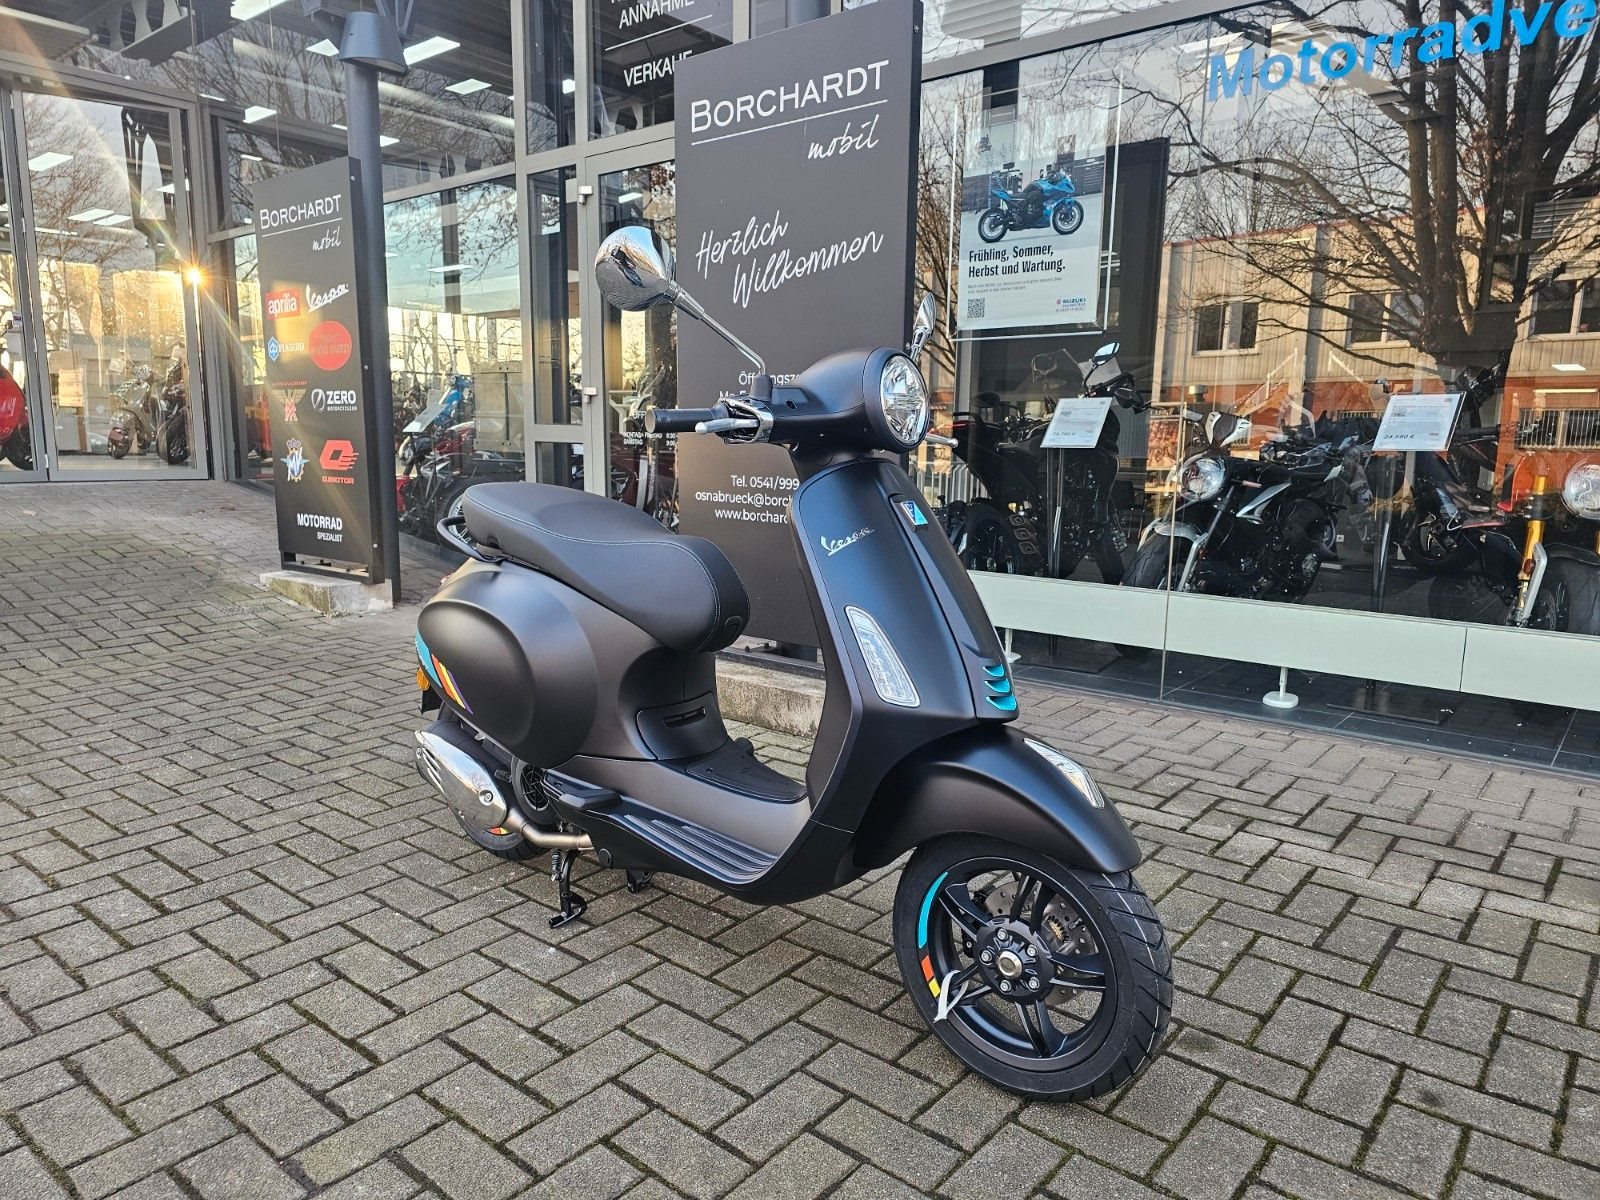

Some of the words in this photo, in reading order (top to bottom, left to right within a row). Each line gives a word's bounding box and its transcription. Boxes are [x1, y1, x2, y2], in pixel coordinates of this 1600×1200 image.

[1208, 0, 1598, 102] Motorradve
[807, 114, 880, 160] mobil
[312, 226, 342, 251] mobil
[695, 210, 788, 280] Herzlich
[968, 248, 1010, 263] Frühling,
[1012, 245, 1054, 259] Sommer,
[732, 231, 884, 309] Willkommen
[968, 264, 999, 278] Herbst
[1001, 262, 1020, 275] und
[1022, 259, 1066, 273] Wartung.
[268, 293, 298, 317] aprilia
[305, 284, 350, 314] Vespa
[326, 390, 357, 404] ZERO
[731, 475, 748, 487] Tel.
[749, 476, 800, 490] 0541/999
[297, 513, 343, 531] MOTORRAD
[316, 531, 343, 542] SPEZIALIST
